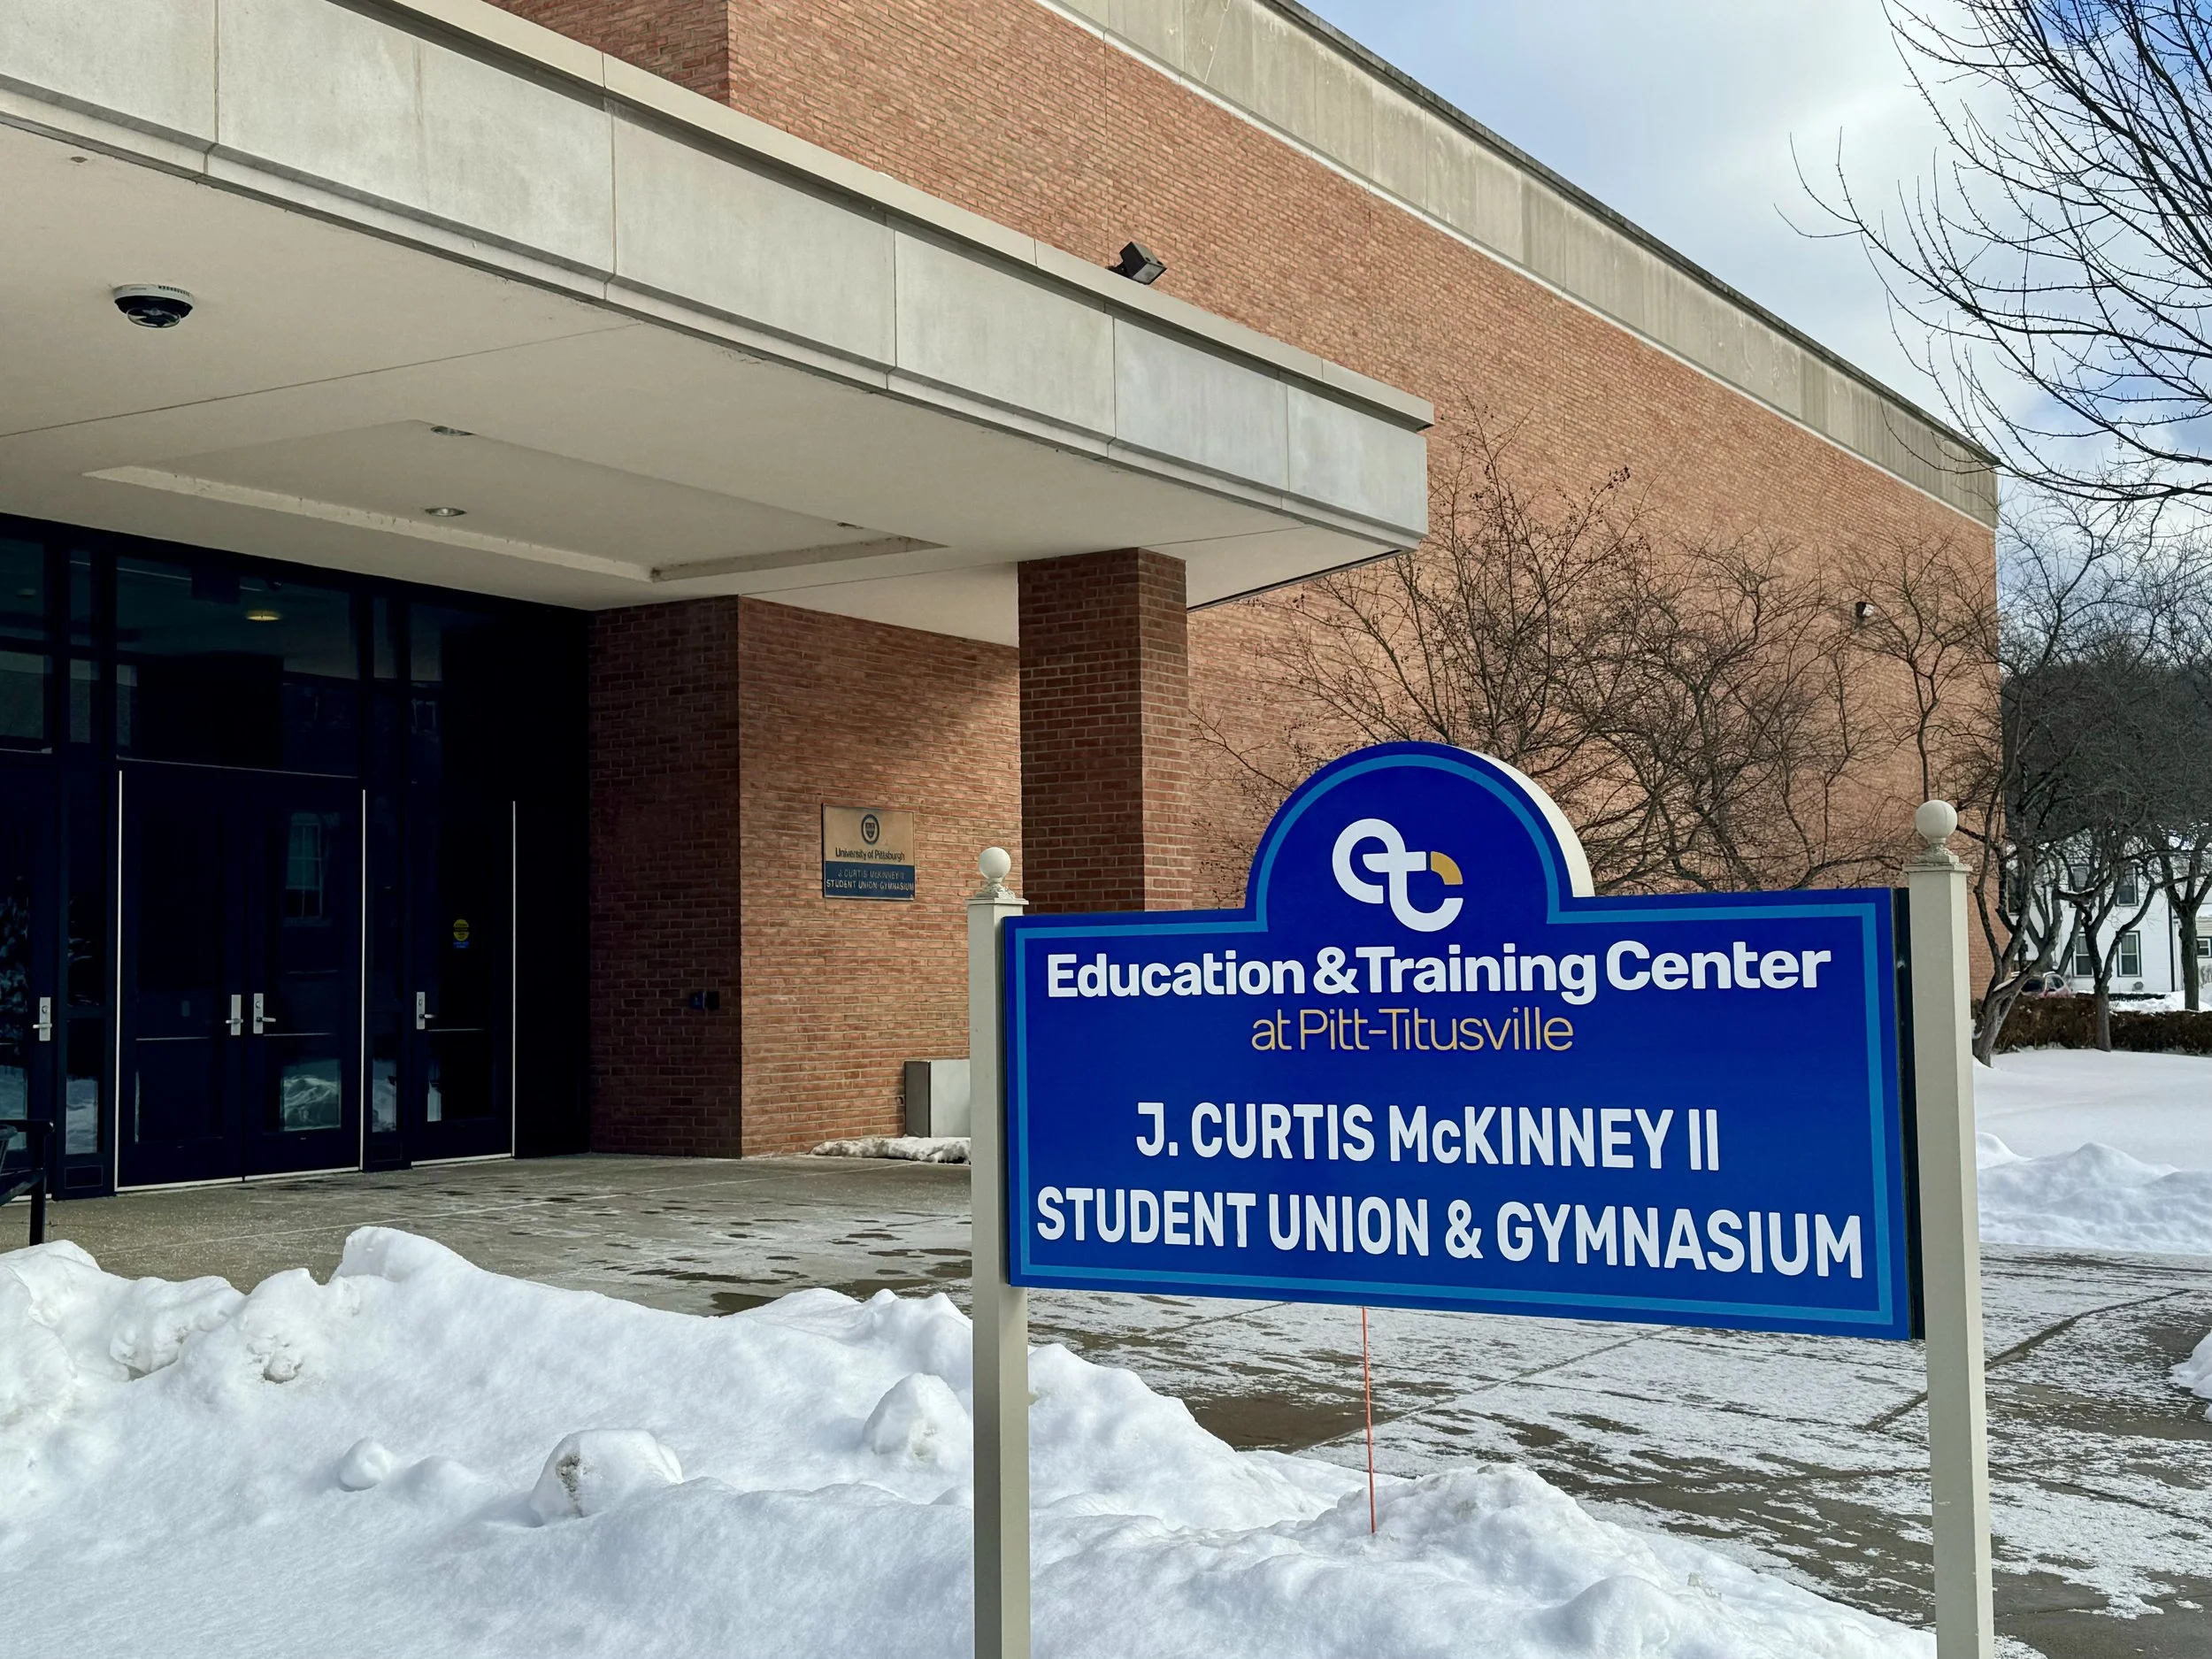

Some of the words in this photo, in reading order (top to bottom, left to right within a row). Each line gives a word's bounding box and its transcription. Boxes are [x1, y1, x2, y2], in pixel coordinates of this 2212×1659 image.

[835, 848, 866, 860] University
[867, 850, 873, 859] of
[874, 850, 904, 862] Pittsburgh
[843, 869, 868, 879] CURTIS
[870, 870, 899, 880] McKINNEY
[826, 879, 856, 888] STUDENT
[1048, 949, 1305, 998] Education
[1313, 946, 1358, 995] &
[1356, 943, 1597, 1005] Training
[1606, 940, 1832, 991] Center
[1251, 1009, 1292, 1051] at
[1300, 1006, 1573, 1051] Pitt-Titusville
[1136, 1102, 1179, 1158] J.
[1191, 1102, 1375, 1162] CURTIS
[1389, 1105, 1674, 1170] McKINNEY
[1688, 1109, 1719, 1171] II
[1036, 1186, 1256, 1248] STUDENT
[1269, 1194, 1429, 1256] UNION
[1445, 1199, 1485, 1259] &
[1496, 1201, 1863, 1279] GYMNASIUM
